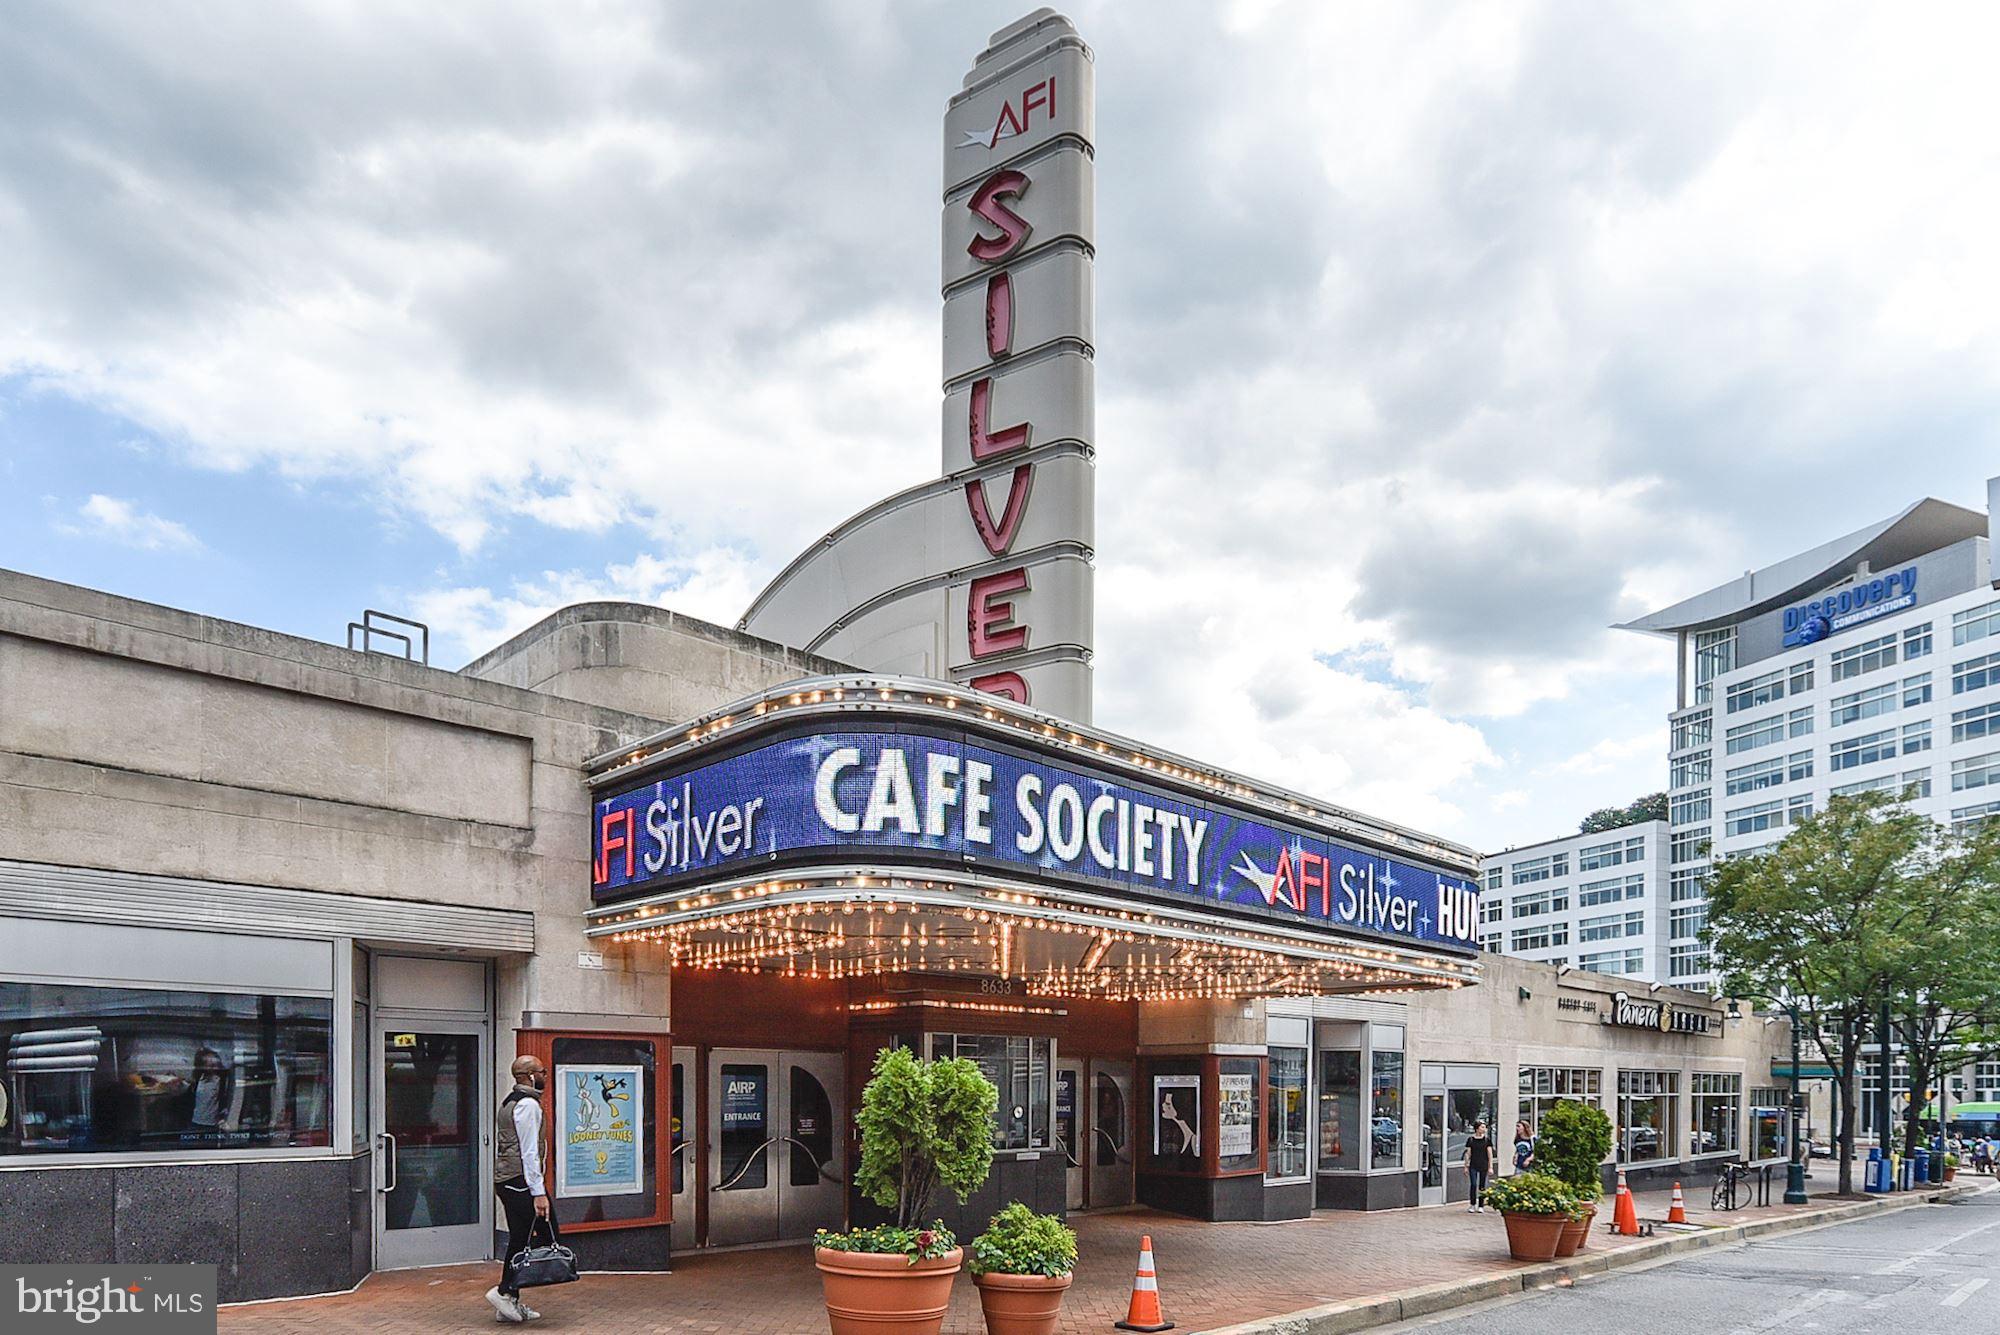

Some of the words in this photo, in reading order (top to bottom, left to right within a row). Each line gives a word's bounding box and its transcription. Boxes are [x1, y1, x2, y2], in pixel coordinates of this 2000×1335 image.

[990, 76, 1055, 149] AFI
[594, 808, 634, 884] FI
[643, 782, 764, 873] Silver
[815, 748, 993, 845] CAFE
[1016, 773, 1208, 886] SOCIETY
[1267, 846, 1330, 916] AFI
[1338, 863, 1420, 932] Silver
[980, 980, 1012, 994] 8633
[1616, 992, 1659, 1028] Panera
[727, 1081, 756, 1094] AIRP
[724, 1112, 761, 1121] ENTRANCE
[569, 1130, 603, 1145] LOONEY
[605, 1129, 633, 1143] TUNES
